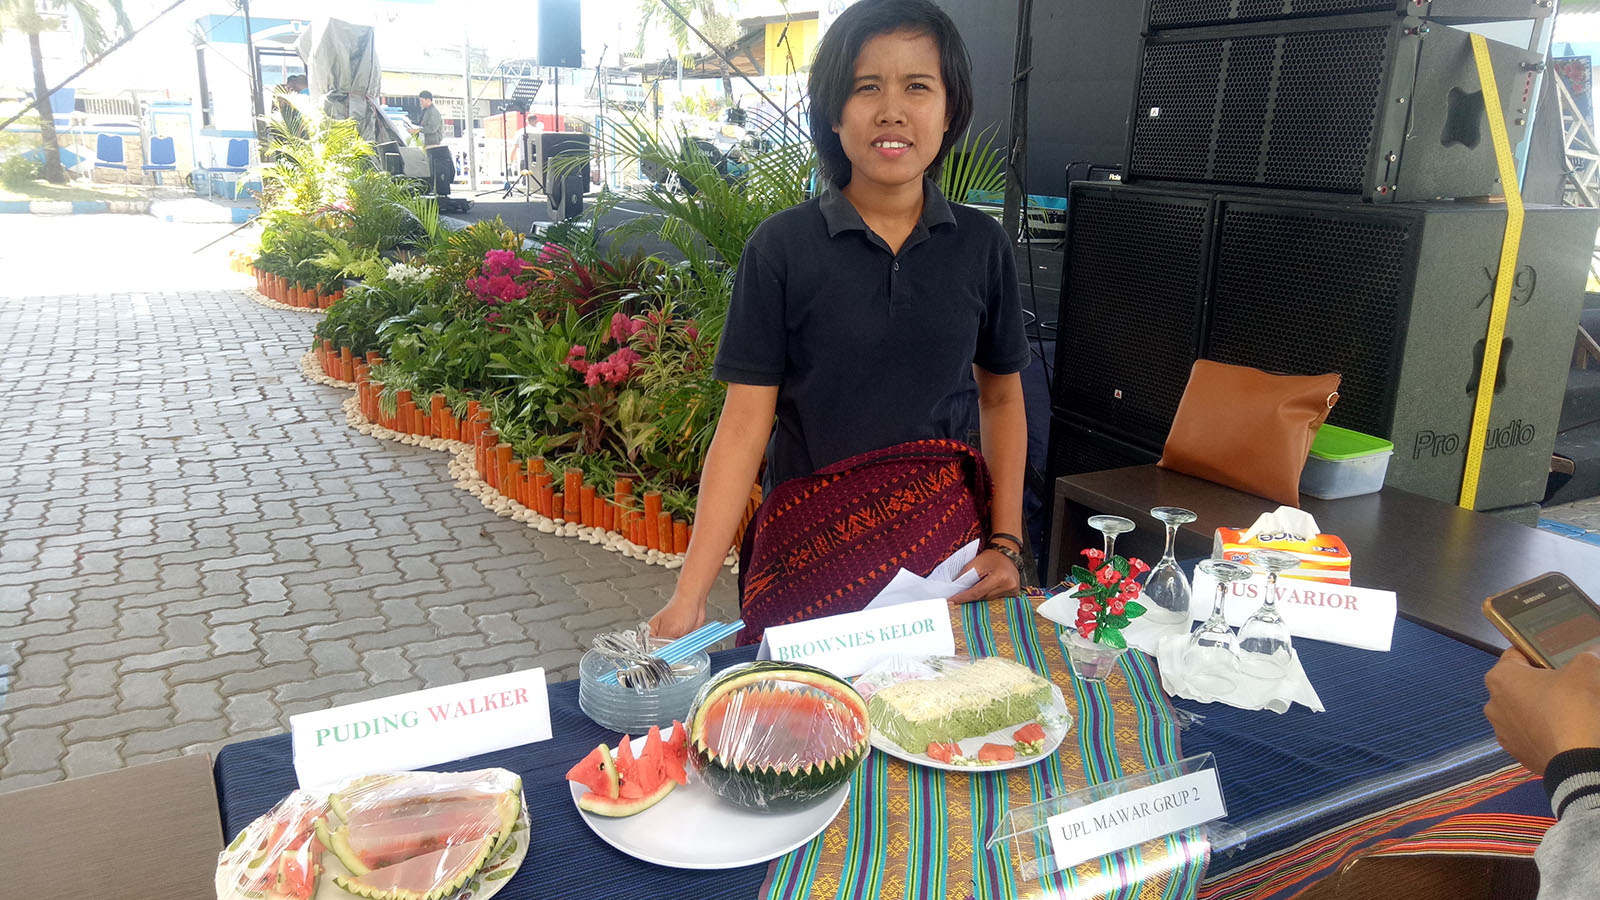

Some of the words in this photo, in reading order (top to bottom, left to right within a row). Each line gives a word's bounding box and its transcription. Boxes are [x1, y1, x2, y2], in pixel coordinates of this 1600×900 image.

[1413, 430, 1459, 460] Pro
[1462, 419, 1536, 454] udio
[1224, 582, 1258, 599] US
[778, 630, 875, 661] BROWNIES
[880, 619, 935, 641] KELOR
[315, 711, 419, 747] PUDING
[427, 687, 529, 722] WALKER
[1061, 821, 1091, 840] UPL
[1093, 802, 1151, 831] MAWAR
[1153, 790, 1190, 813] GRUP
[1192, 787, 1201, 801] 2
